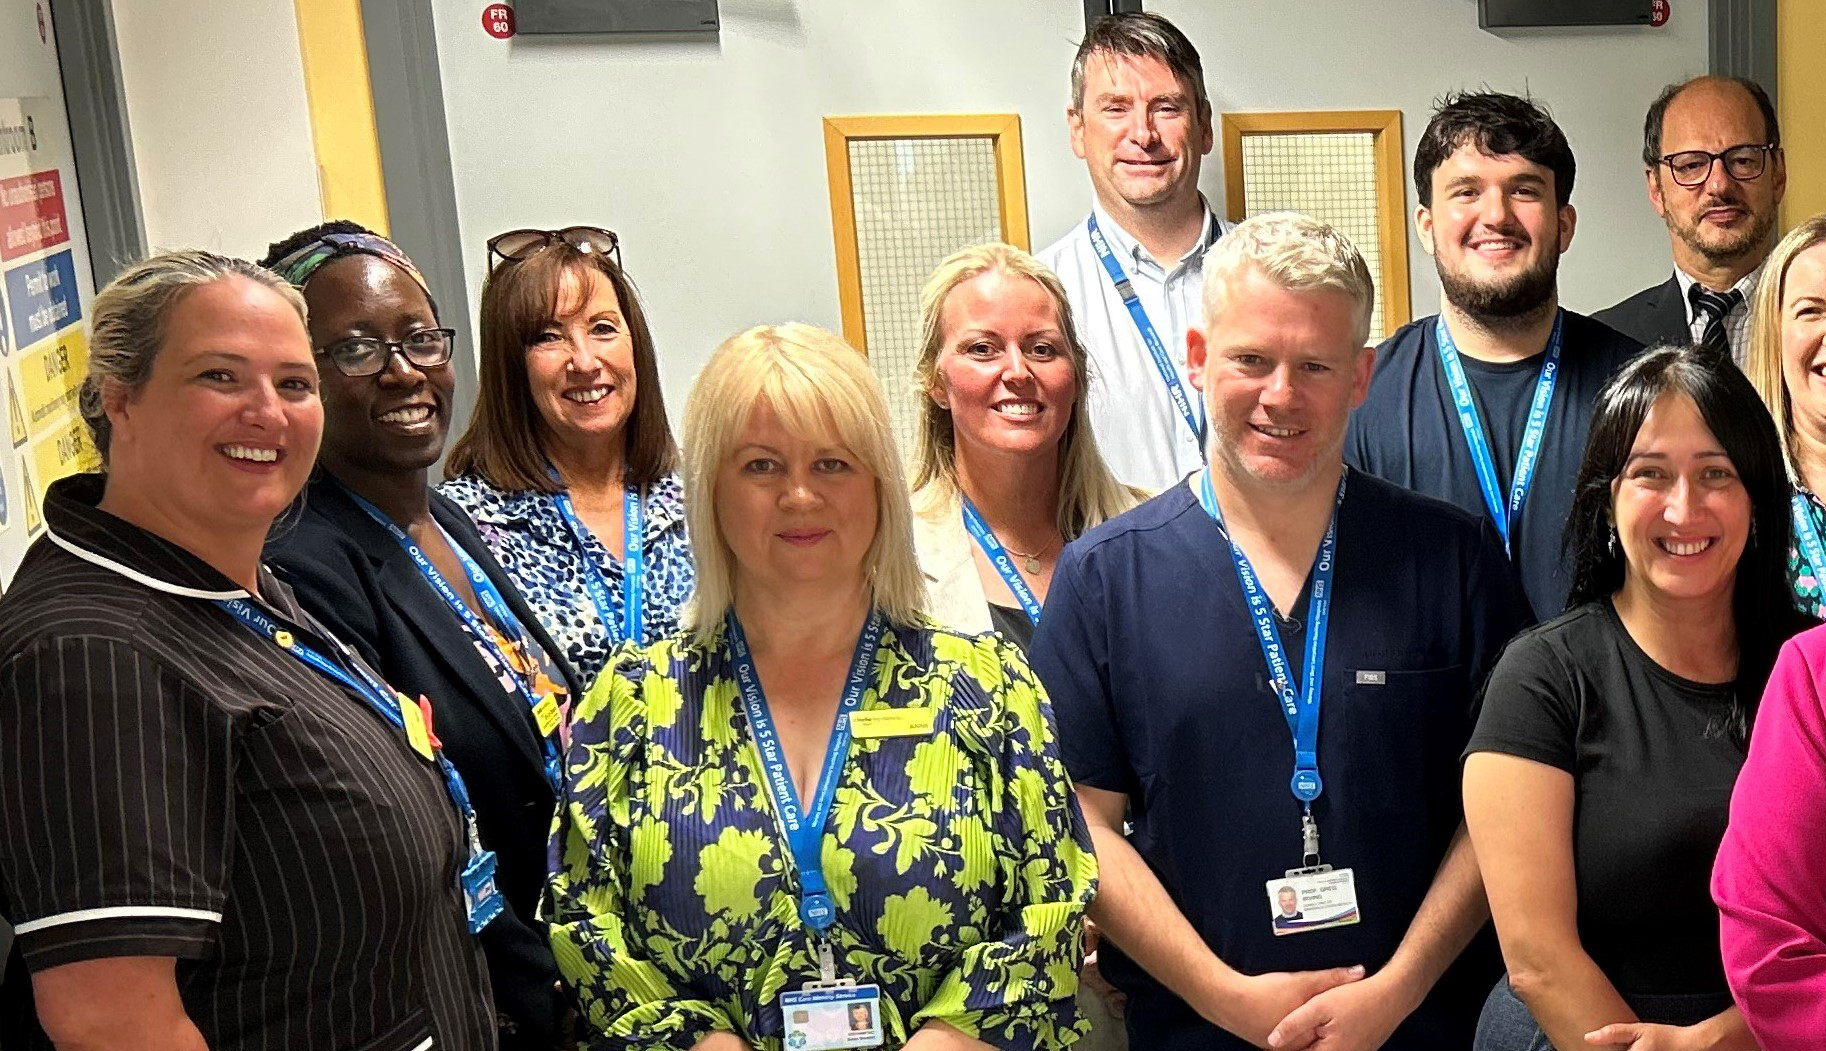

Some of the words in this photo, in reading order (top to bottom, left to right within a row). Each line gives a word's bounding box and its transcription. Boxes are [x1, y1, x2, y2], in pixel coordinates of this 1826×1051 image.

[491, 9, 507, 20] FR
[493, 22, 508, 32] 60
[44, 344, 70, 382] DANGER
[1544, 362, 1556, 378] Our
[1170, 382, 1190, 418] NIHR
[1536, 380, 1552, 408] Vision
[1512, 487, 1524, 511] Care
[628, 502, 639, 536] Vision
[628, 537, 639, 552] Our
[996, 556, 1013, 574] Our
[1319, 547, 1331, 572] Our
[409, 545, 428, 567] Our
[428, 566, 455, 601] Vision
[1239, 560, 1257, 594] Vision
[226, 598, 250, 620] Visi
[1250, 595, 1261, 605] is
[1255, 608, 1266, 616] 5
[867, 630, 876, 640] 5
[1258, 619, 1273, 643] Star
[864, 640, 874, 652] is
[851, 650, 870, 687] Vision
[845, 686, 860, 707] Our
[1282, 689, 1297, 716] Care
[738, 663, 752, 683] Our
[746, 684, 762, 721] Vision
[757, 719, 767, 730] is
[762, 739, 778, 764] Star
[770, 764, 791, 802] Patient
[784, 803, 799, 831] Care
